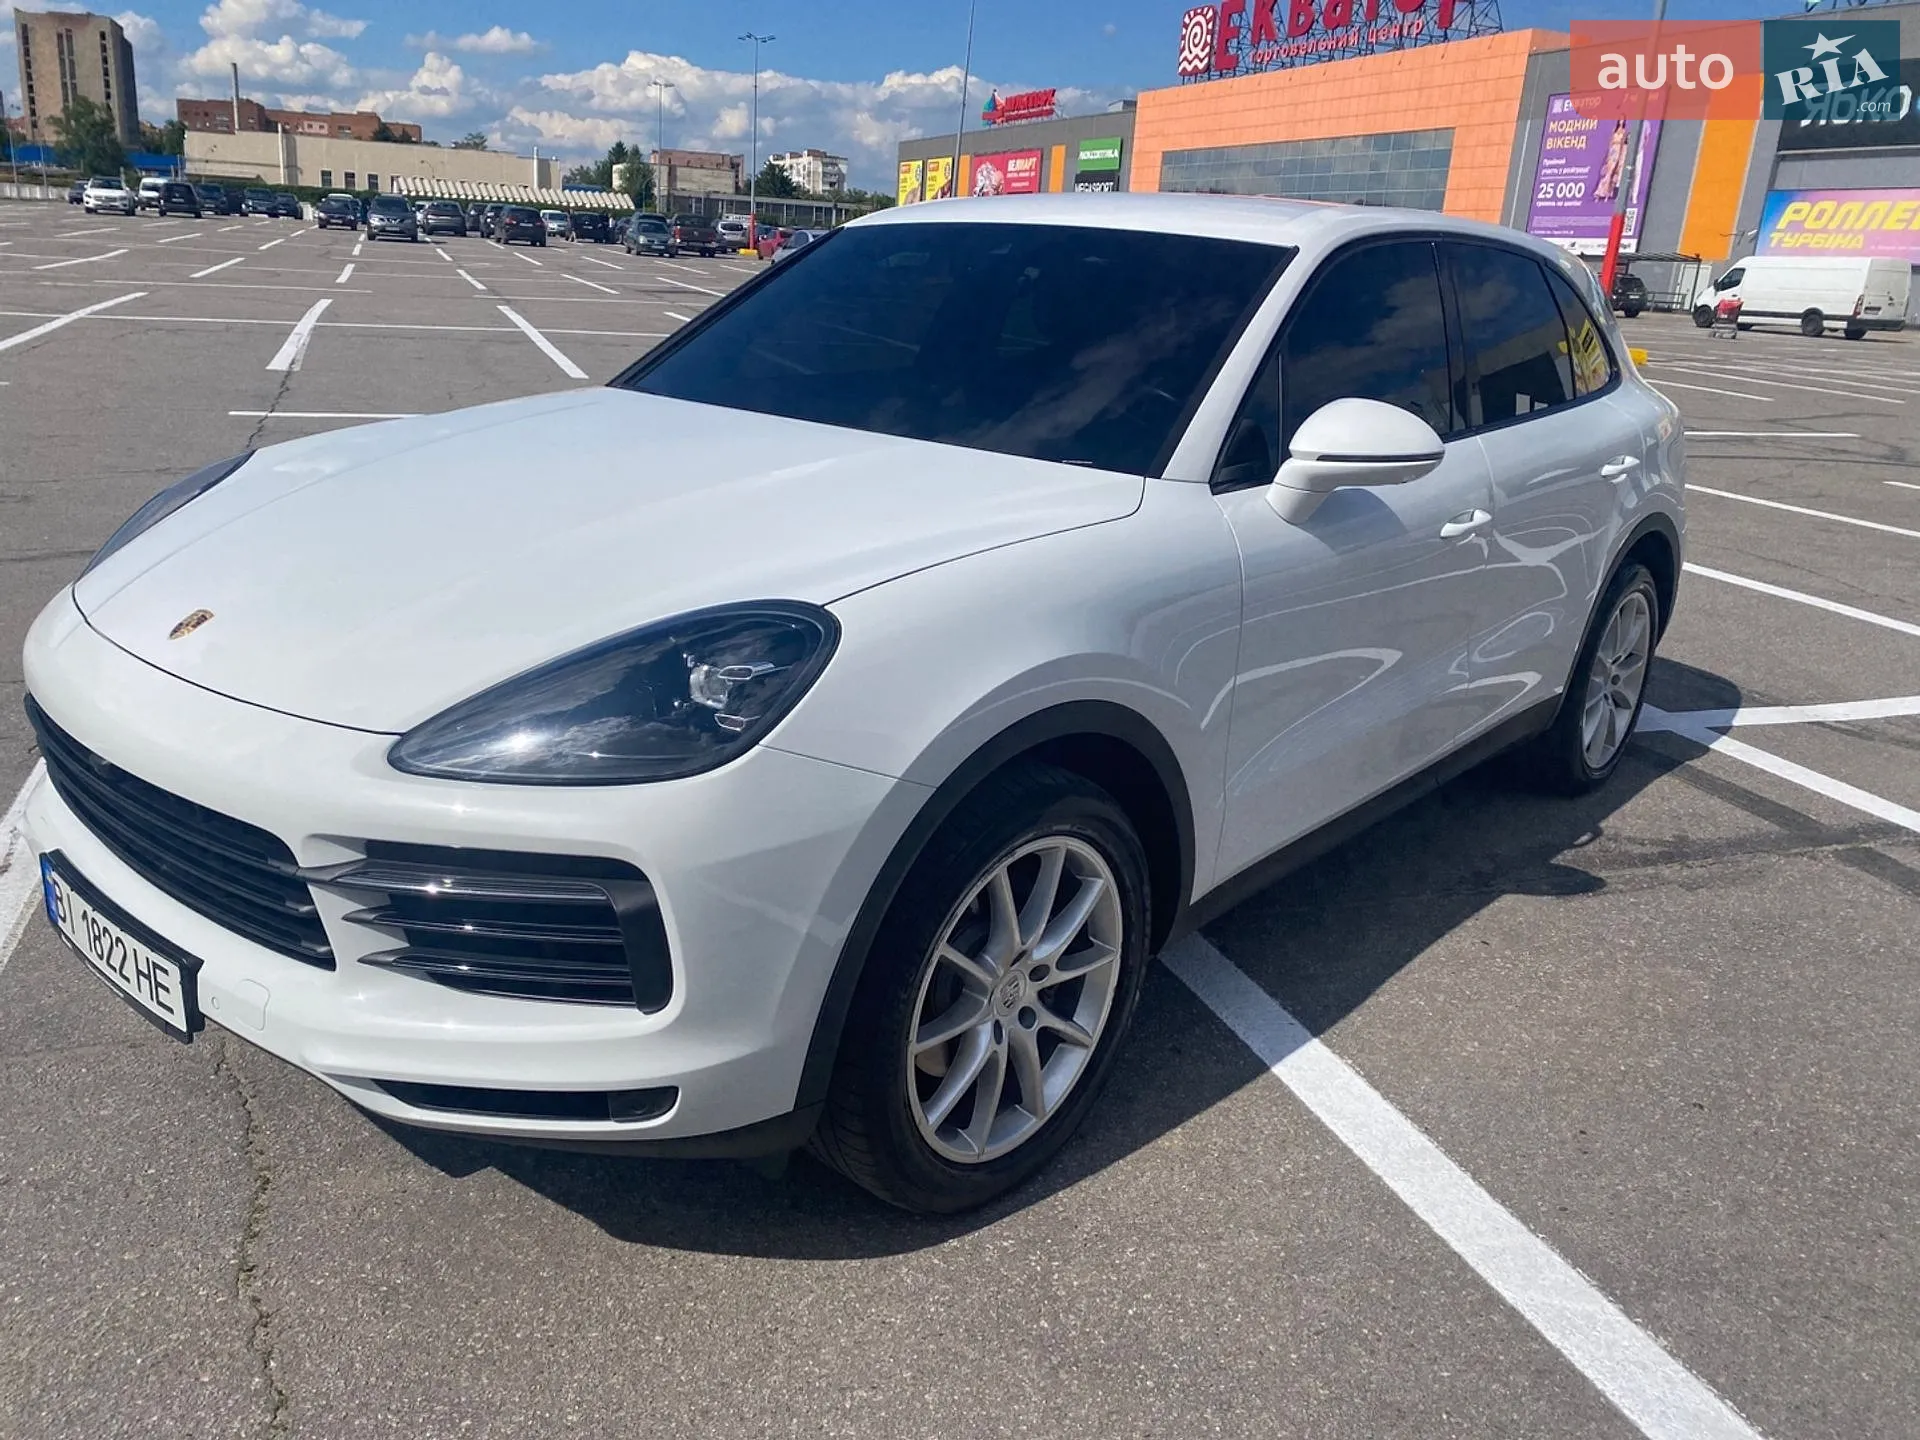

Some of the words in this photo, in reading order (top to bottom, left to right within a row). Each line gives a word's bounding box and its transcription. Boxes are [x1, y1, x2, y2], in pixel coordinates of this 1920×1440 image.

[1250, 25, 1360, 64] торговельний
[1368, 17, 1425, 45] центр
[1549, 115, 1598, 133] МОДНИЙ
[1546, 136, 1587, 150] ВІКЕНД
[1537, 182, 1555, 199] 25
[1556, 182, 1586, 198] 000
[1770, 232, 1865, 249] ТУРБІНА
[53, 878, 75, 935] BI
[82, 910, 130, 984] 1822
[133, 948, 174, 1015] HE
